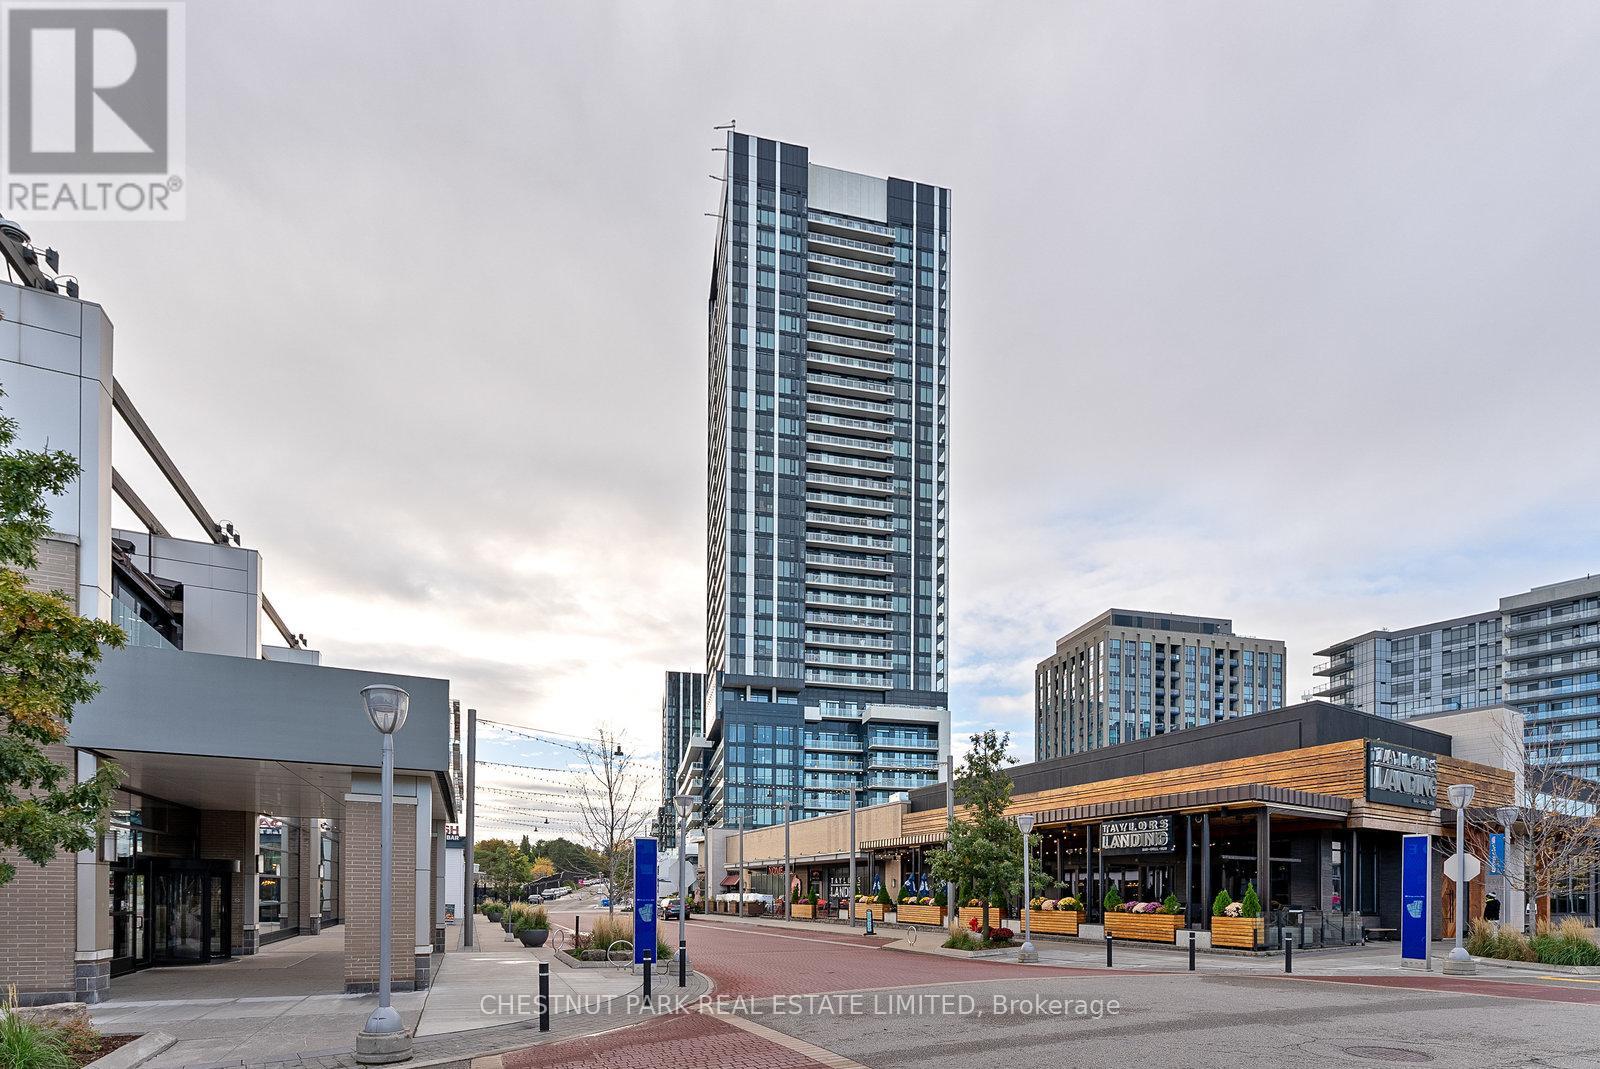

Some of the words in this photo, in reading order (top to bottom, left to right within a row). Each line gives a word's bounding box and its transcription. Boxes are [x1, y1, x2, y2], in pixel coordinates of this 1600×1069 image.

[1372, 746, 1437, 773] TAYLORS
[1372, 766, 1437, 798] LANDING
[1103, 819, 1168, 833] TAYLORS
[1102, 832, 1168, 849] LANDING
